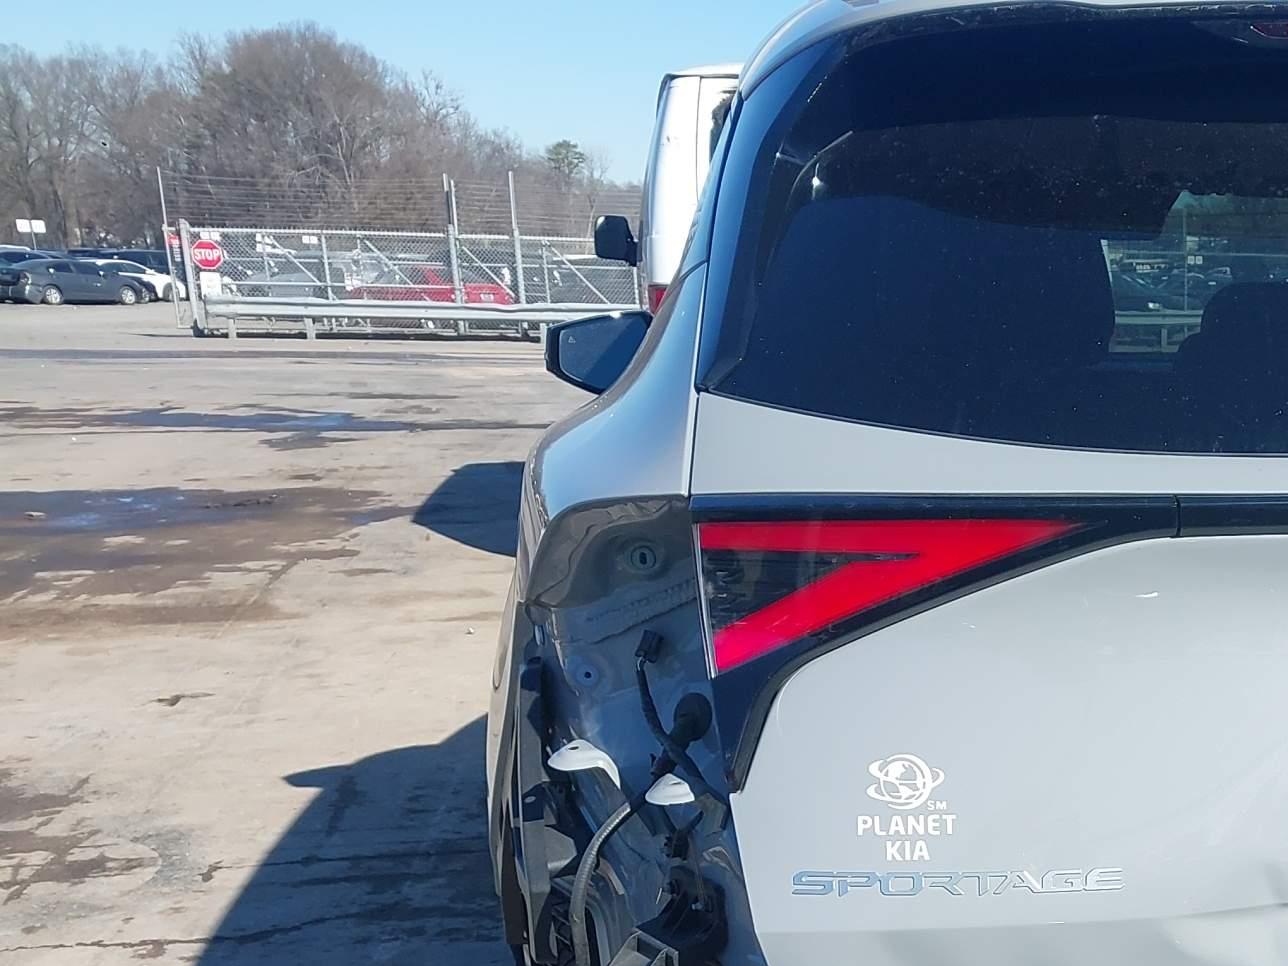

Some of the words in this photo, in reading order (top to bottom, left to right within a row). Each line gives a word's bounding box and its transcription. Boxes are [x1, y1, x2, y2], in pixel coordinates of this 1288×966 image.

[194, 248, 220, 261] STOP
[857, 815, 956, 837] PLANET
[886, 841, 930, 861] KIA
[791, 867, 1126, 897] SPORTAGE
